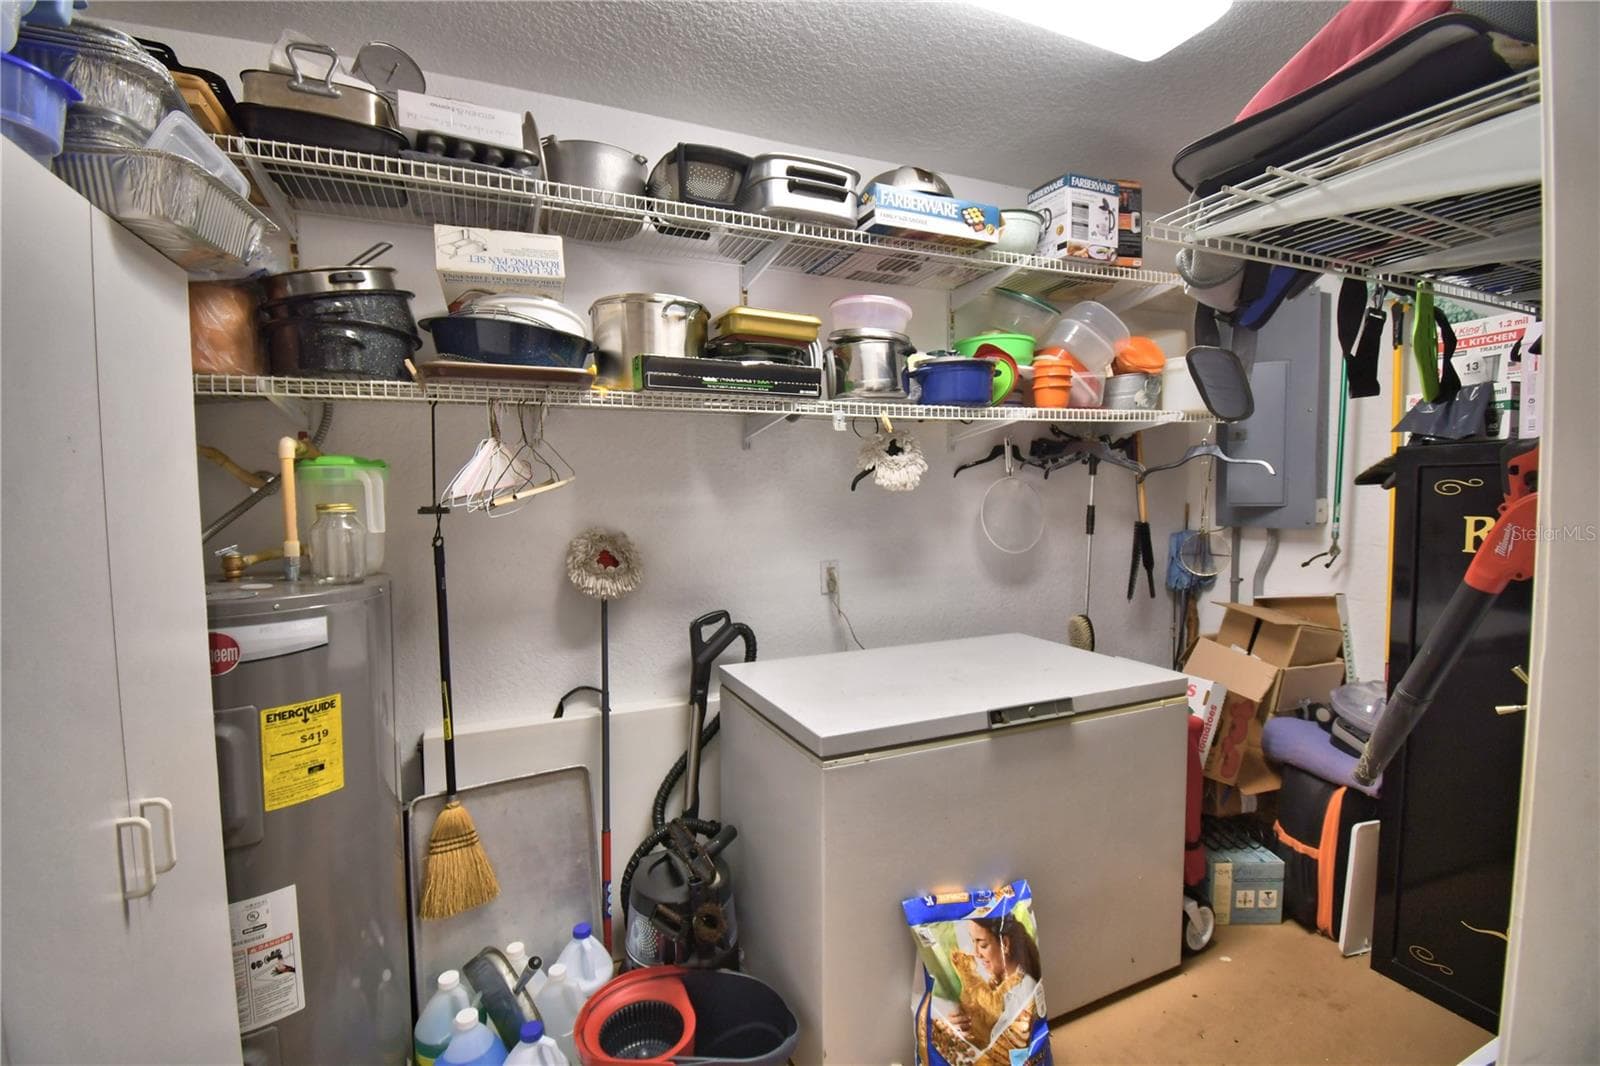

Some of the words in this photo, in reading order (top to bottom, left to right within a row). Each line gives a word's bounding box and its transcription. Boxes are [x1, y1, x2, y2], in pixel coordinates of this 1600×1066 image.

[1028, 177, 1065, 202] FARBERWARE
[1071, 176, 1116, 194] FARBERWARE
[880, 190, 959, 218] FARBERWARE
[468, 255, 486, 264] SET
[488, 256, 508, 266] PAN
[510, 257, 560, 269] ROASTING
[1499, 319, 1513, 329] 1.2
[1514, 317, 1529, 326] mil
[1469, 331, 1518, 347] KITCHEN
[1480, 345, 1503, 353] TRASH
[1466, 361, 1480, 372] 13
[266, 699, 337, 724] ENERGYGUIDE
[300, 728, 330, 744] $419
